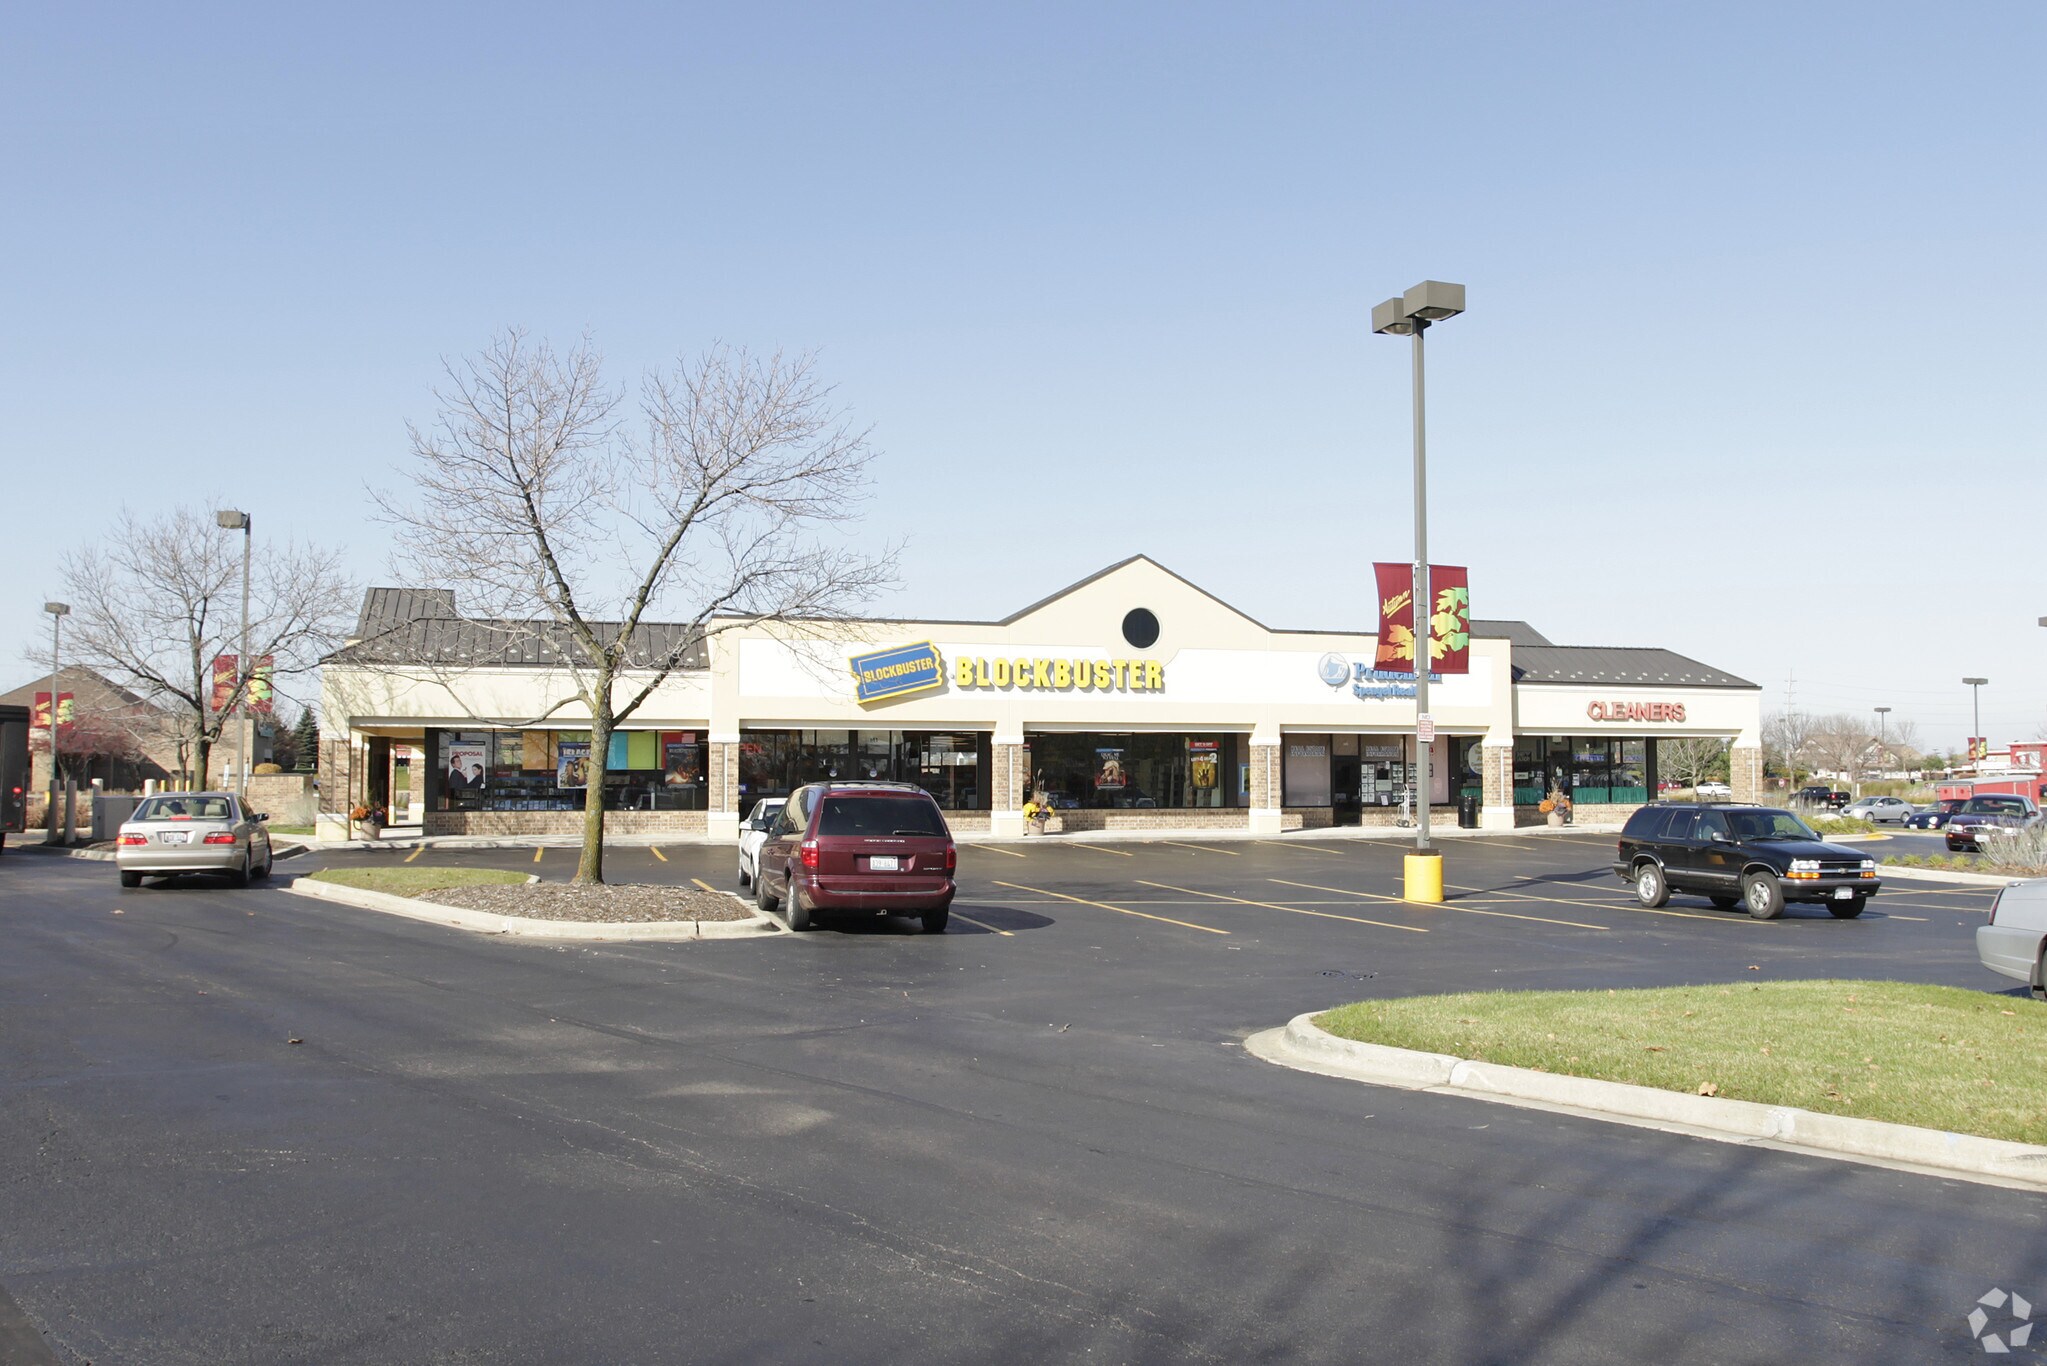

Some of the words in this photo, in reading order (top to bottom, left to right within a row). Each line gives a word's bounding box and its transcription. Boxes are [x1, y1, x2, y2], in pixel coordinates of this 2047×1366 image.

[863, 656, 934, 683] BLOCKBUSTER
[955, 655, 1163, 691] BLOCKBUSTER
[1587, 700, 1686, 722] CLEANERS
